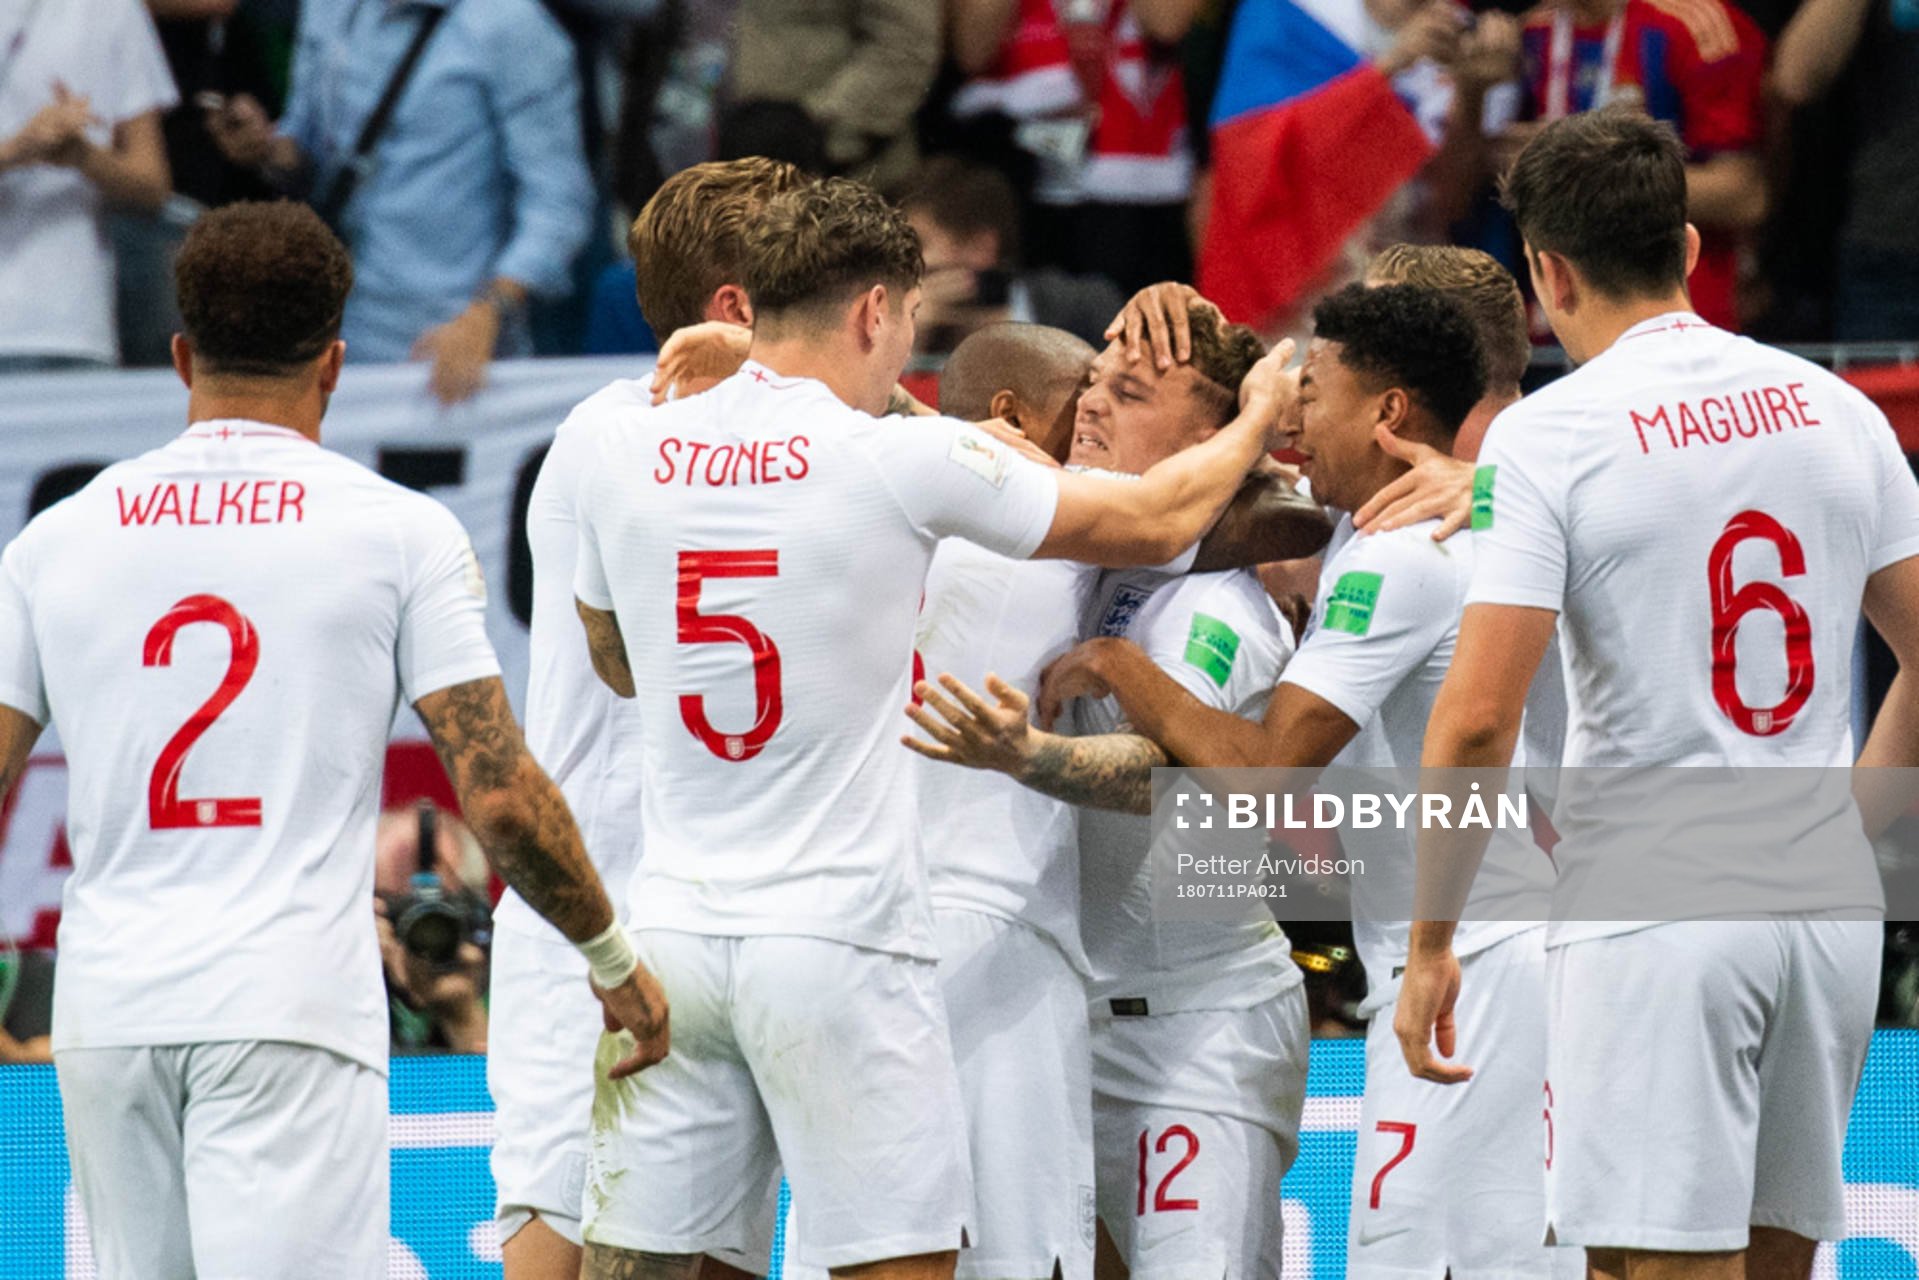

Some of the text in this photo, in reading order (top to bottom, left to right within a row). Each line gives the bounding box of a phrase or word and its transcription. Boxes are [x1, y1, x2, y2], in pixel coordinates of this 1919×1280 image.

[653, 434, 810, 487] STONES
[1629, 382, 1821, 454] MAGUIRE
[116, 480, 306, 527] WALKER
[675, 548, 784, 762] 5
[1707, 509, 1816, 737] 6
[141, 593, 263, 831] 2
[1138, 1123, 1200, 1215] 12
[1369, 1120, 1417, 1210] 7
